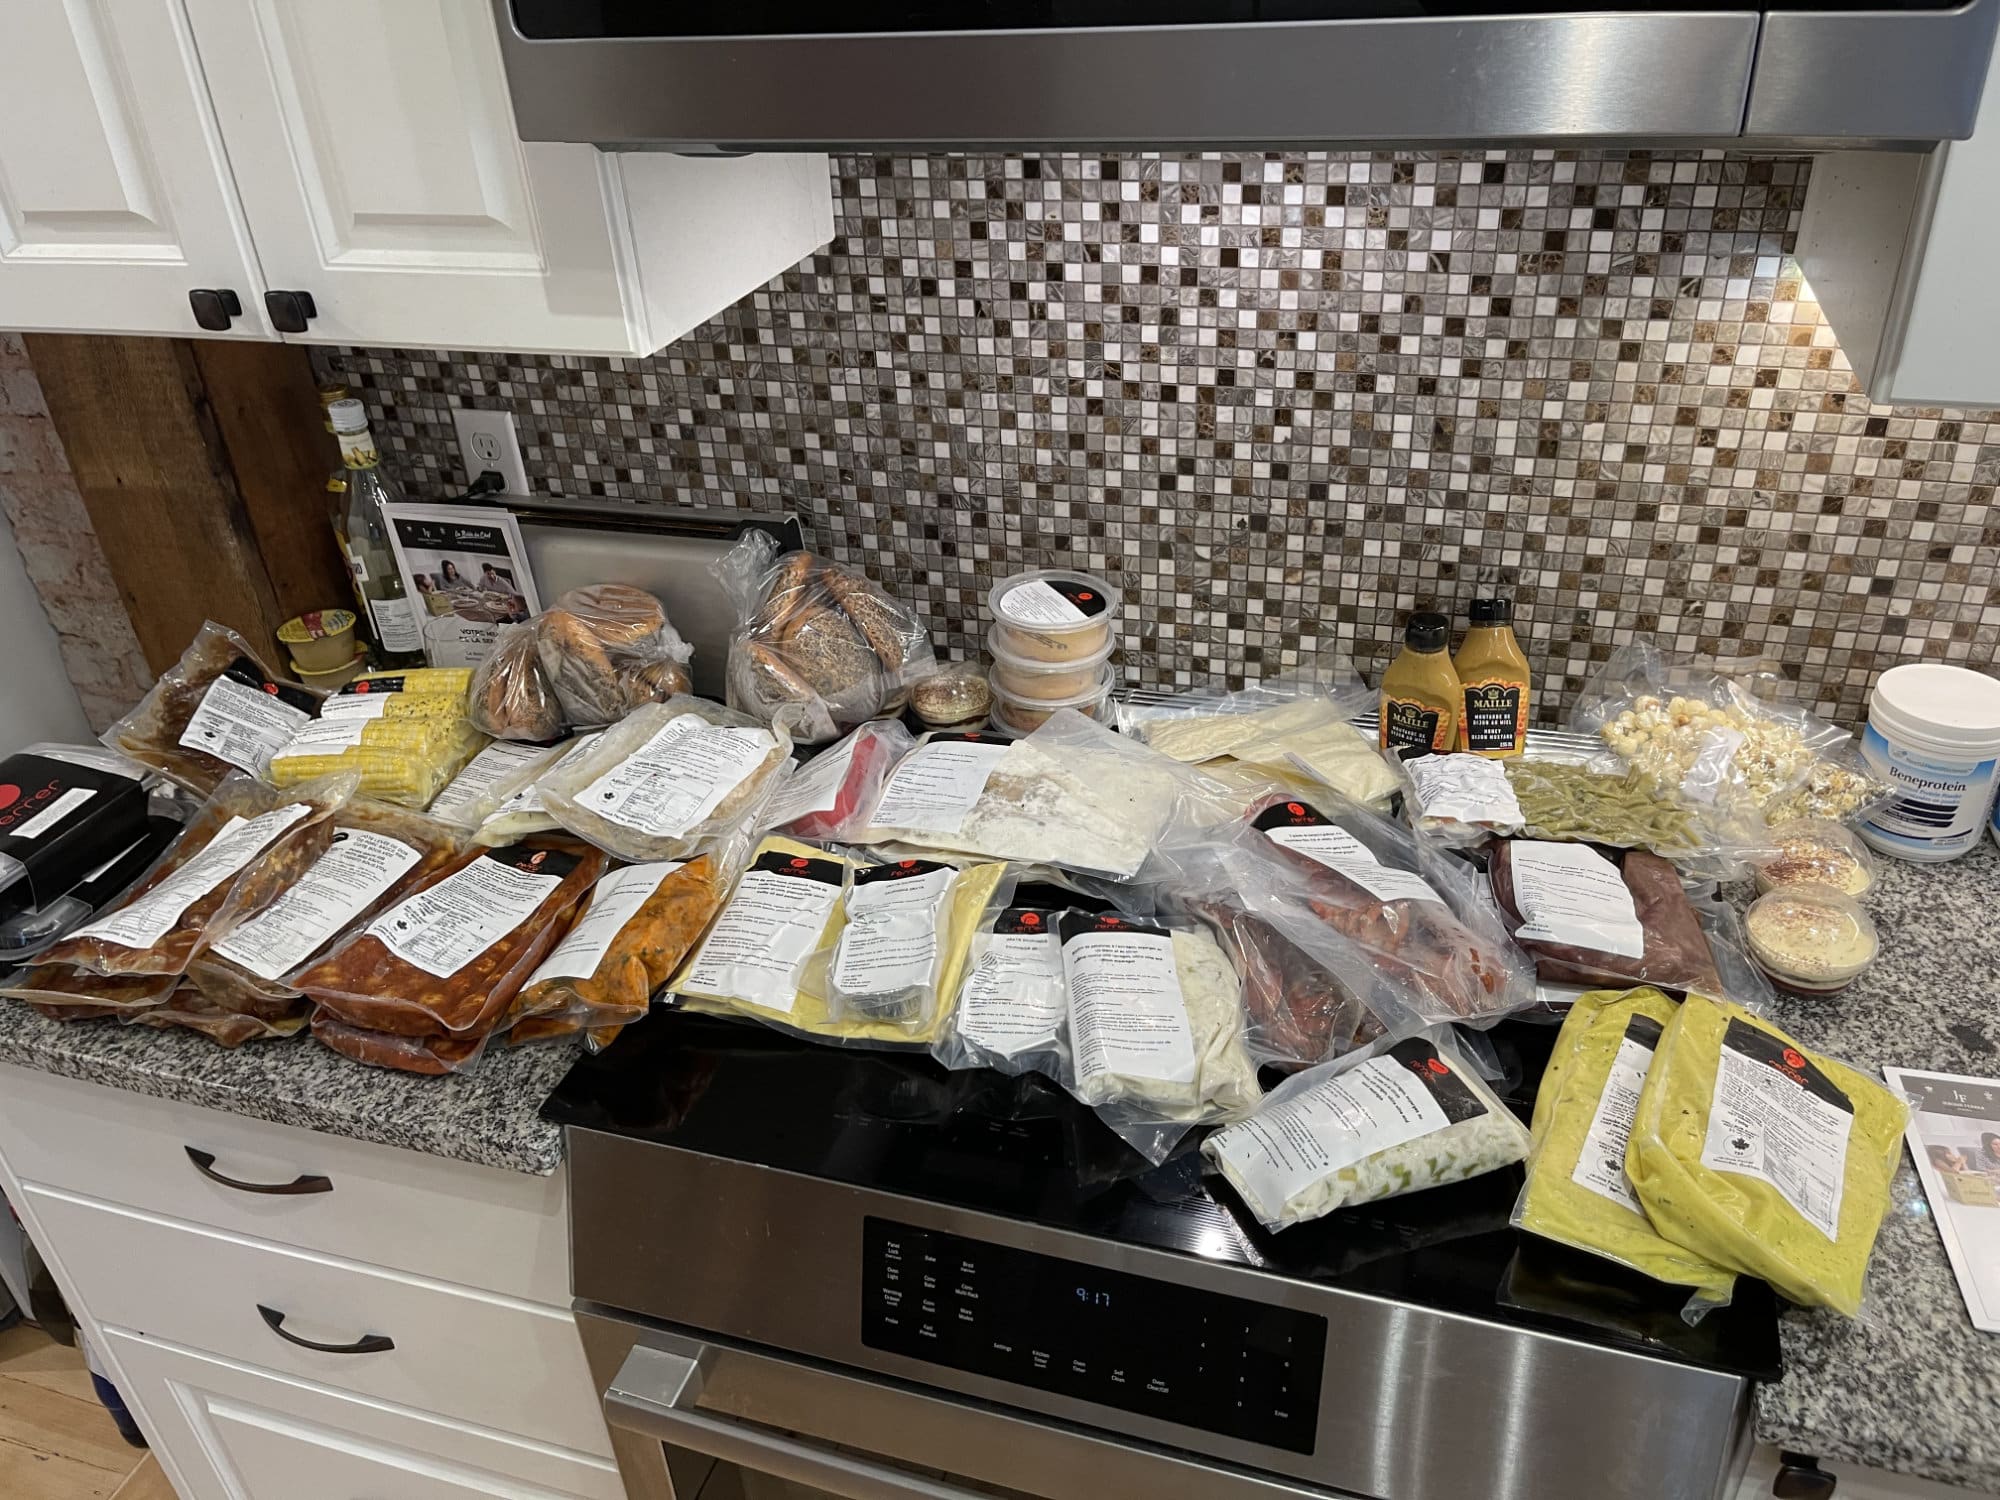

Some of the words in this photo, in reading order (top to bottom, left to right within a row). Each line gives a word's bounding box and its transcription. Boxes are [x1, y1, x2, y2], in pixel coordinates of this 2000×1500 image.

[460, 628, 485, 637] VOTRE
[1474, 699, 1512, 708] MAILLE
[1393, 713, 1430, 728] MAILLE
[1889, 765, 1967, 792] Beneprotein
[0, 779, 60, 826] errer
[1076, 1287, 1110, 1307] 9:17
[993, 1342, 1012, 1352] Settings
[1072, 1359, 1087, 1367] Oven
[1072, 1365, 1087, 1374] Timer
[1113, 1369, 1124, 1377] Self
[1111, 1375, 1126, 1384] Clean
[1152, 1378, 1165, 1387] Oven
[1274, 1409, 1289, 1419] Enter
